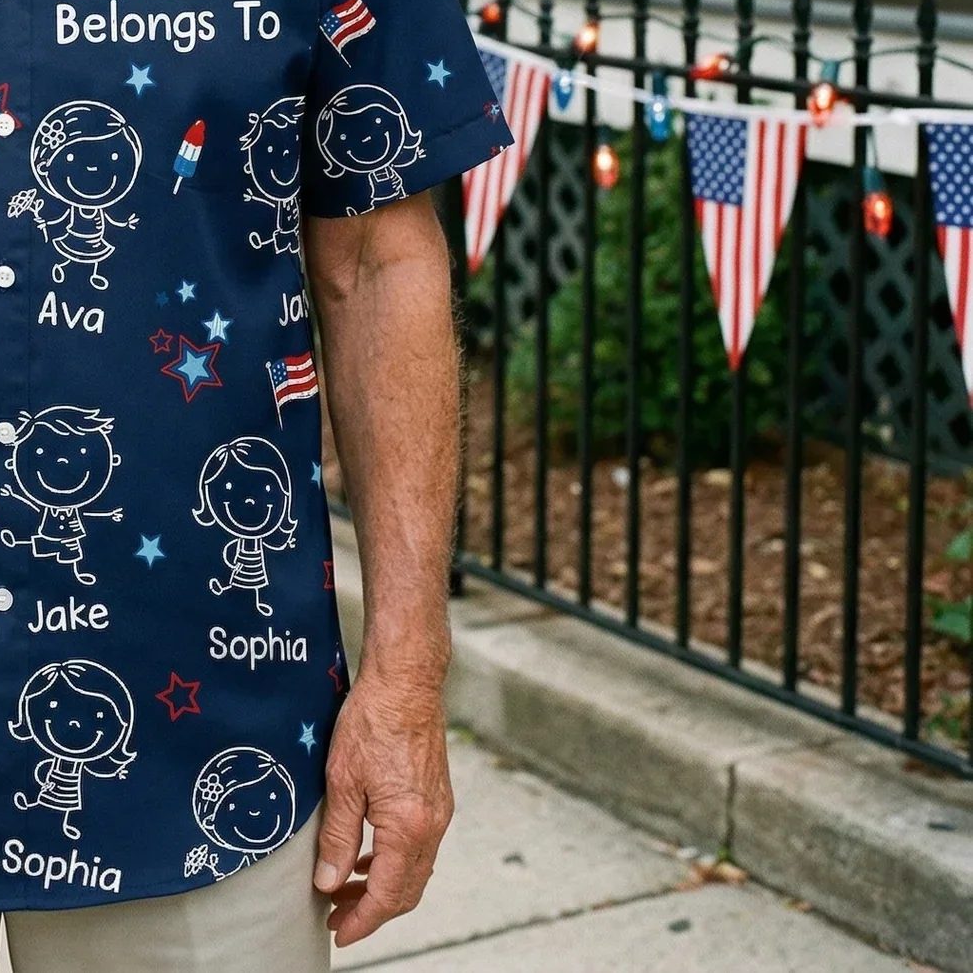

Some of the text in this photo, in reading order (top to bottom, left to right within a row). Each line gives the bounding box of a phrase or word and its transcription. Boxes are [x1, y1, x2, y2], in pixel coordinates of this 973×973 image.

[55, 0, 281, 54] Belongs To
[37, 291, 106, 335] Ava
[27, 596, 110, 633] Jake
[209, 626, 308, 671] Sophia
[1, 838, 123, 894] Sophia
